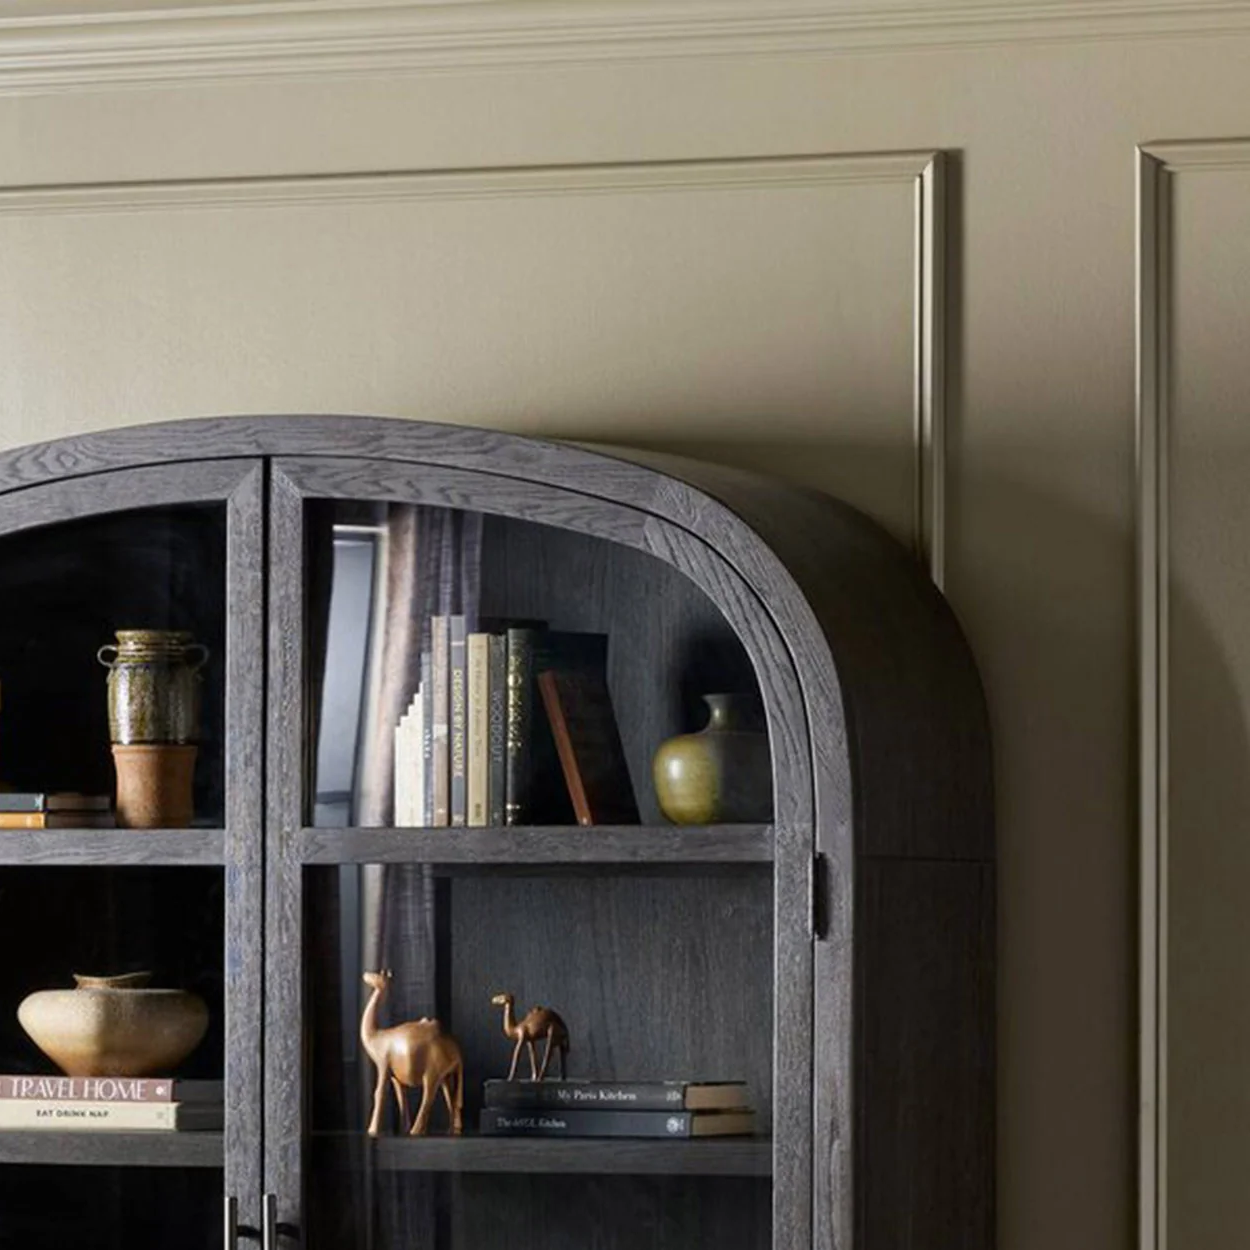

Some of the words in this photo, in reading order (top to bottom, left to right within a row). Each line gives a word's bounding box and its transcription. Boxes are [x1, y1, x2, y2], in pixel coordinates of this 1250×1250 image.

[453, 669, 463, 713] DESIGN
[453, 714, 463, 729] BY
[490, 690, 504, 762] WOODCUT
[453, 732, 463, 777] NATURE
[9, 1078, 79, 1099] TRAVEL
[82, 1079, 148, 1101] HOME
[573, 1088, 597, 1101] Paris
[598, 1088, 638, 1101] Kitchen
[36, 1109, 53, 1118] EAT
[57, 1110, 85, 1118] DRINK
[89, 1110, 109, 1118] NAP
